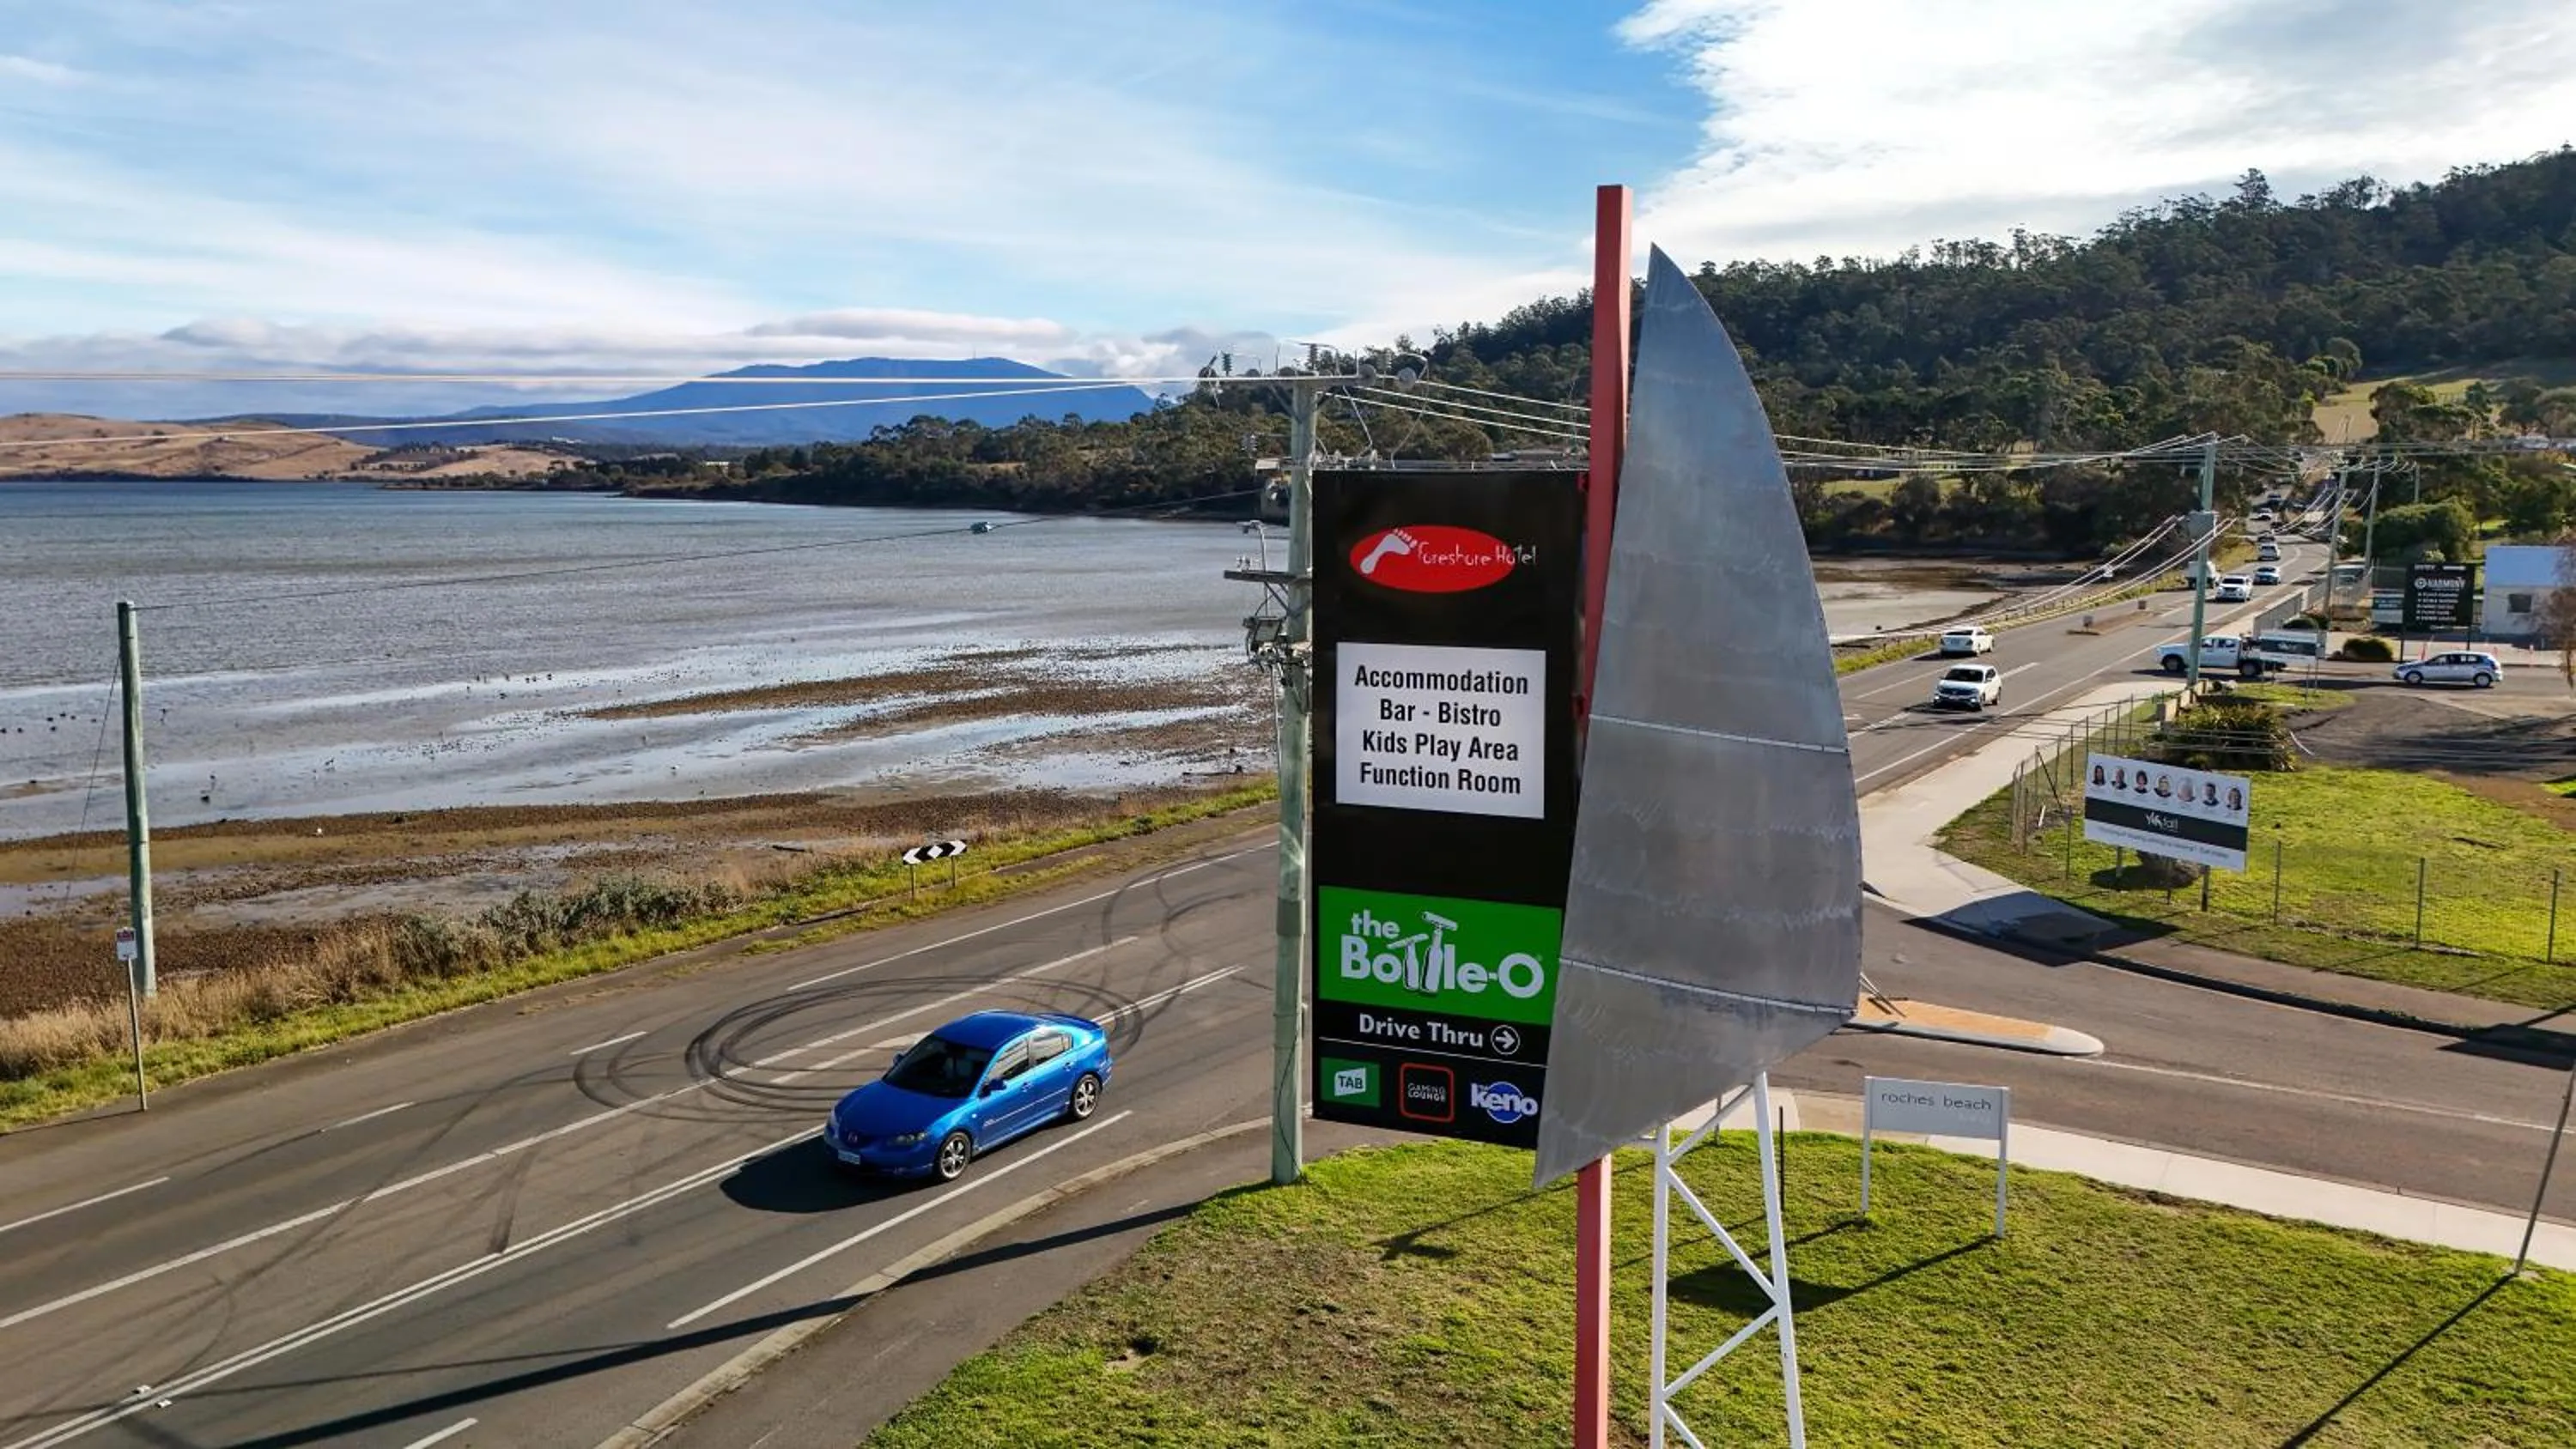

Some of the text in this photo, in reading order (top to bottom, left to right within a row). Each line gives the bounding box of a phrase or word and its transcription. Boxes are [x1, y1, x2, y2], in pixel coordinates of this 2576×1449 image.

[1354, 664, 1528, 694] Accommodation
[1380, 698, 1416, 722] Bar
[1438, 701, 1501, 727] Bistro
[1363, 730, 1519, 763] Kids Play Area
[1360, 761, 1521, 795] Function Room
[1351, 909, 1400, 939] the
[1359, 1013, 1483, 1048] Drive Thru
[1338, 1075, 1364, 1089] TAB
[1407, 1082, 1446, 1095] GAMING
[1407, 1089, 1446, 1103] LOUNGE
[1471, 1082, 1538, 1115] keno
[1881, 1091, 1992, 1111] roches beach
